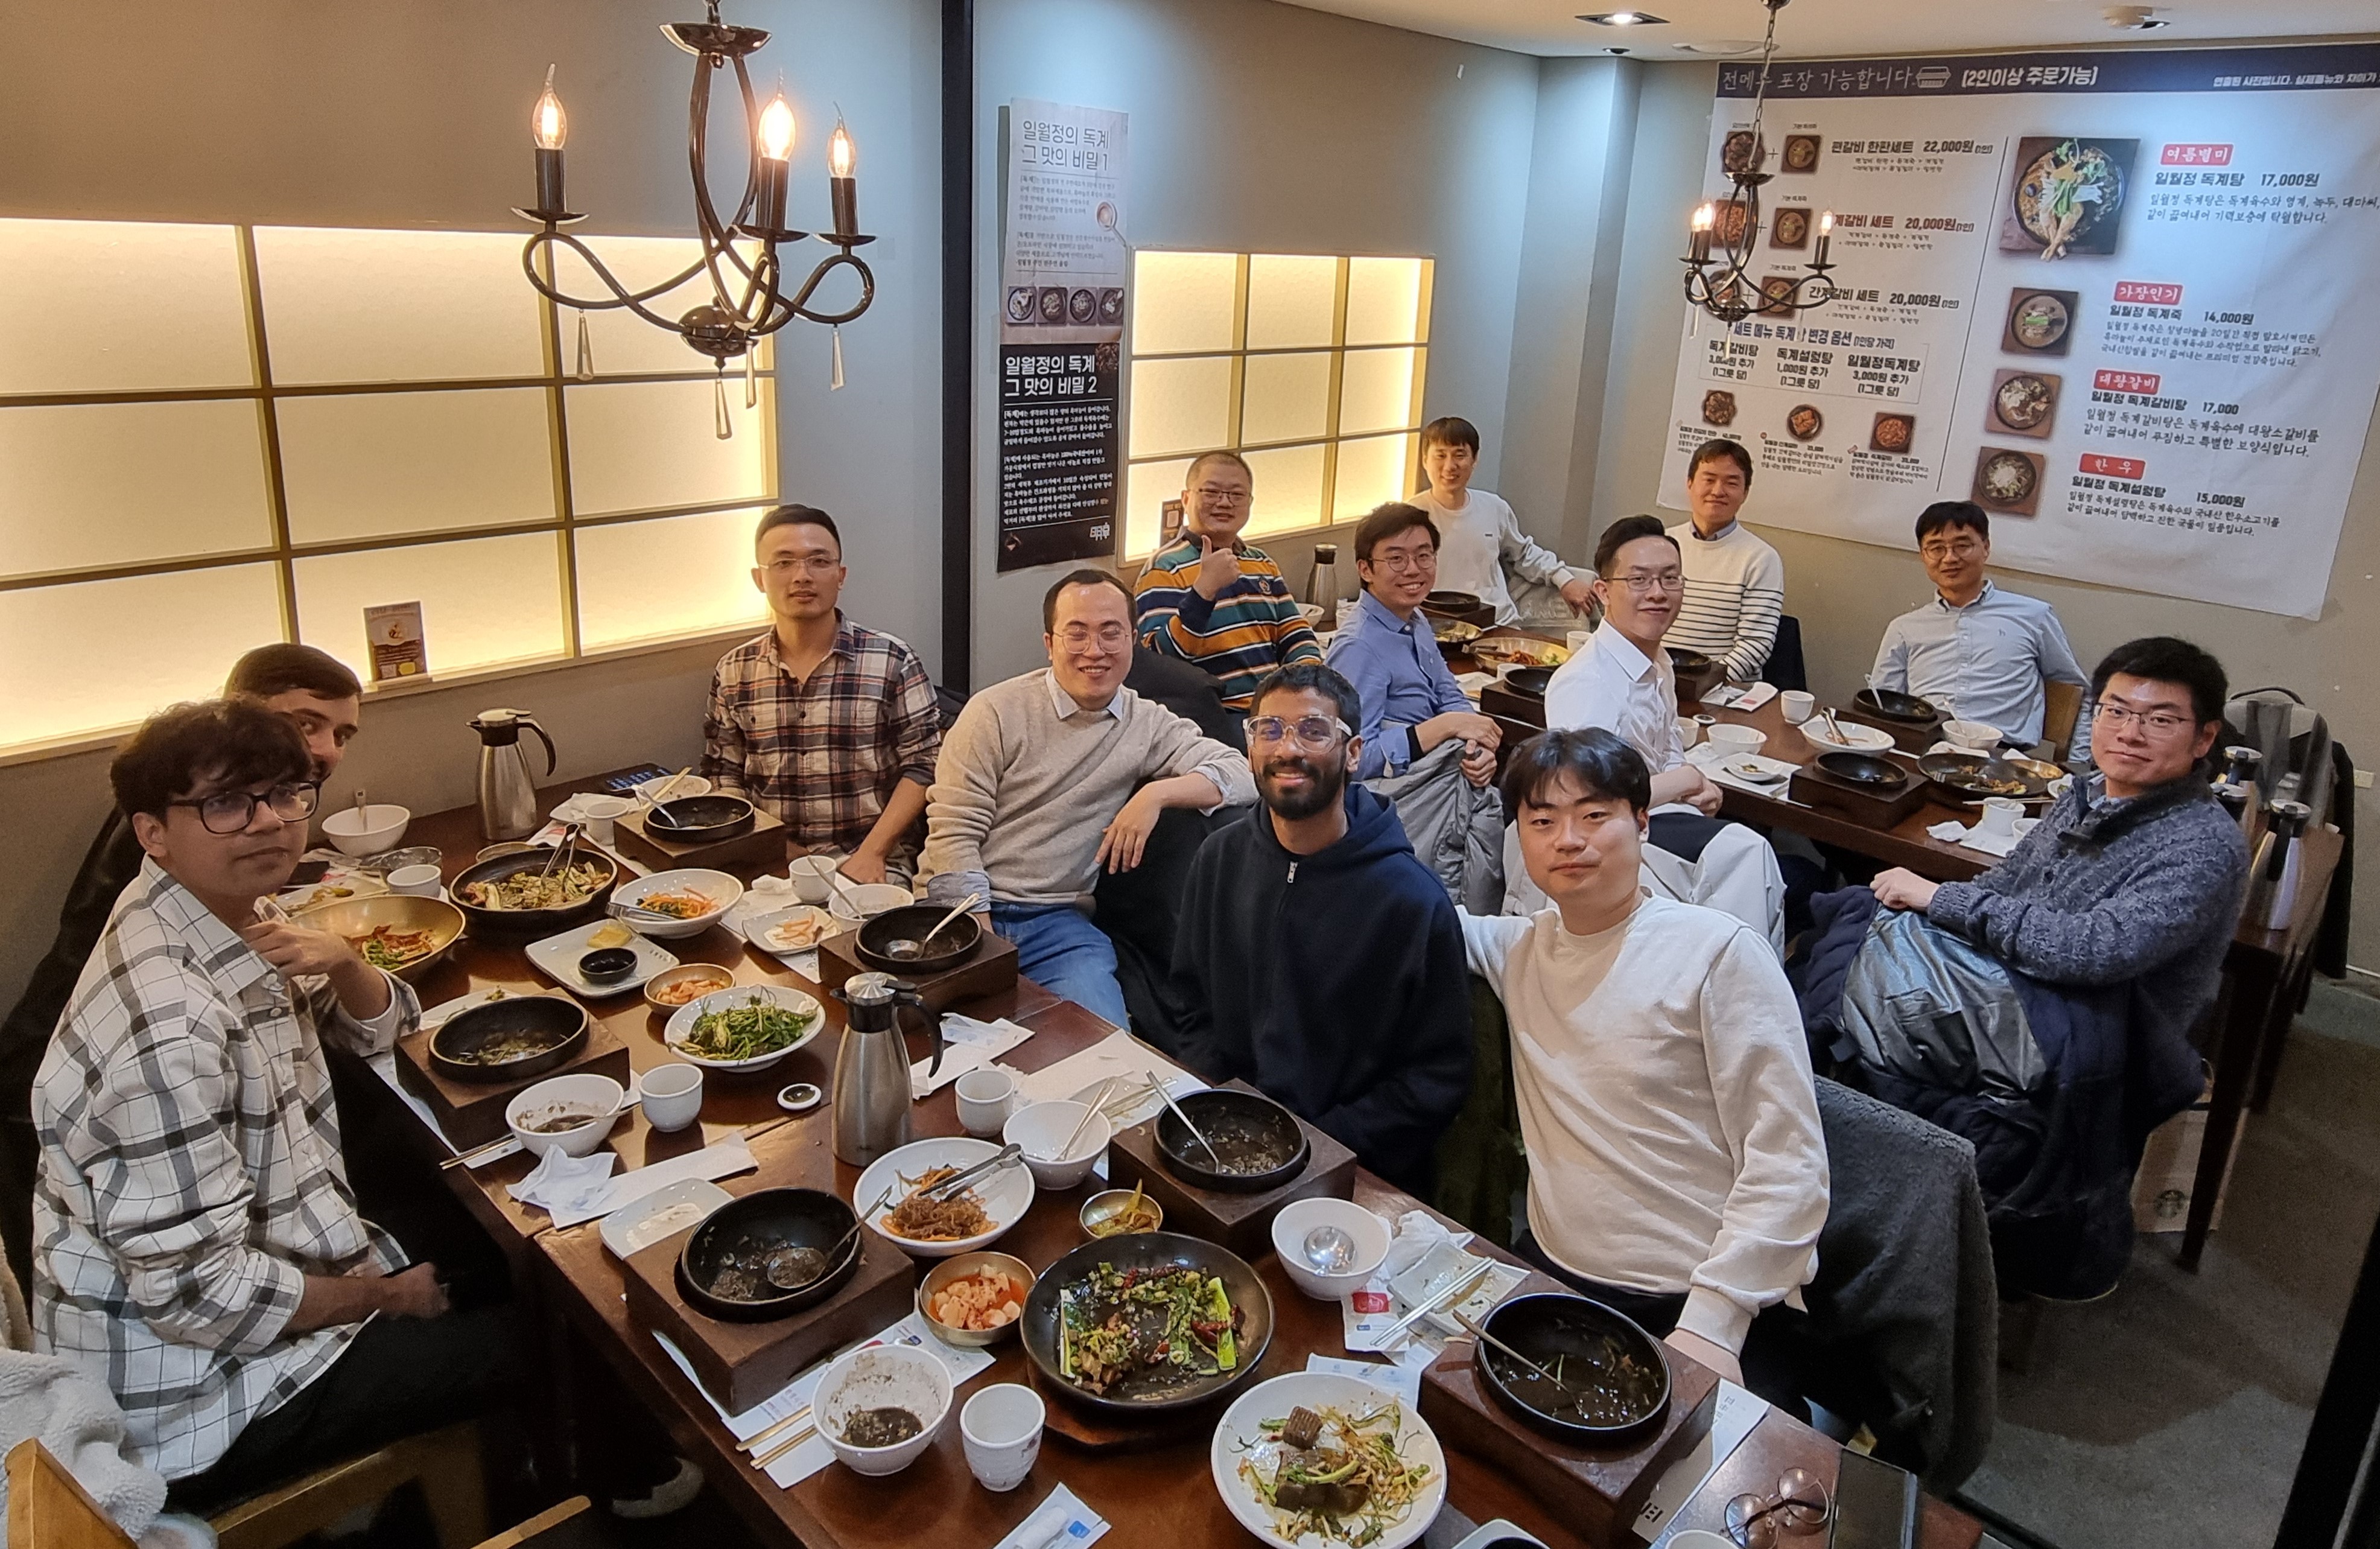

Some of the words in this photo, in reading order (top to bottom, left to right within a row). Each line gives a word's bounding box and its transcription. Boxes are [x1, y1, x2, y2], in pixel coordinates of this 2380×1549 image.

[1777, 69, 1814, 92] 포장
[1022, 120, 1079, 146] 일월정의
[1082, 128, 1110, 150] 독계
[1021, 144, 1037, 164] 그
[1041, 147, 1068, 168] 맛의
[1071, 151, 1099, 171] 비밀
[1103, 153, 1108, 171] 1
[1923, 140, 1975, 156] 22,000원
[2166, 146, 2229, 164] 여름별미
[2155, 172, 2198, 186] 일월정
[2200, 173, 2245, 187] 독계탕
[2261, 173, 2321, 188] 17,000원
[2150, 192, 2180, 206] 일월정
[2183, 194, 2225, 207] 독계탕은
[2227, 194, 2282, 208] 독계육수와
[2312, 196, 2339, 209] 녹두,
[1833, 214, 1868, 229] 계갈비
[1870, 215, 1894, 229] 세트
[1905, 217, 1957, 232] 20,000원
[2147, 208, 2167, 221] 같이
[2169, 209, 2211, 222] 끓여내어
[2214, 209, 2267, 224] 기력보충에
[2270, 211, 2328, 225] 탁월합니다.
[1856, 289, 1880, 302] 세트
[1888, 293, 1941, 308] 20,000원
[2119, 284, 2179, 302] 가장인기
[2110, 305, 2145, 319] 일월정
[2147, 307, 2183, 321] 독계죽
[2204, 311, 2255, 326] 14,000원
[1733, 322, 1753, 337] 세트
[1754, 323, 1773, 339] 메뉴
[1808, 329, 1830, 345] 변경
[1830, 330, 1853, 347] 옵션
[2107, 320, 2130, 331] 일월정
[2210, 328, 2240, 339] 20일간
[2216, 340, 2261, 352] 수작업으로
[1005, 354, 1065, 375] 일월정의
[1068, 354, 1096, 374] 독계
[1738, 357, 1755, 369] 추가
[1777, 348, 1834, 365] 독계설렁탕
[1847, 354, 1921, 373] 일월정독계탕
[2151, 348, 2168, 358] 같이
[2169, 349, 2203, 361] 끓여내는
[2204, 352, 2240, 364] 프리미엄
[1777, 362, 1809, 376] 1,000원
[1810, 366, 1829, 378] 추가
[1852, 370, 1888, 383] 3,000원
[1890, 374, 1909, 385] 추가
[1004, 378, 1020, 397] 그
[1024, 377, 1054, 397] 맛의
[1057, 375, 1085, 395] 비밀
[1087, 375, 1097, 393] 2
[2099, 372, 2156, 391] 대왕갈비
[2091, 390, 2125, 405] 일월정
[2128, 394, 2188, 412] 독계갈비탕
[2203, 401, 2240, 415] 17,000
[2087, 408, 2116, 422] 일월정
[2120, 411, 2185, 430] 독계갈비탕은
[2188, 418, 2245, 436] 독계육수에
[2248, 424, 2320, 444] 대왕소갈비를
[2084, 422, 2104, 436] 같이
[2106, 425, 2148, 441] 끓여내어
[2151, 431, 2195, 445] 푸짐하고
[2199, 435, 2235, 451] 특별한
[2236, 440, 2309, 459] 보양식입니다.
[2072, 475, 2106, 490] 일월정
[2108, 480, 2167, 499] 독계설렁탕
[2196, 491, 2246, 509] 15,000원
[2067, 501, 2084, 514] 같이
[2085, 504, 2118, 518] 끓여내어
[2121, 511, 2154, 523] 담백하고
[2157, 515, 2176, 527] 진한
[2177, 518, 2206, 530] 국물이
[2207, 521, 2255, 537] 일품입니다.
[2069, 491, 2093, 503] 일월정
[2095, 495, 2146, 511] 독계설렁탕은
[2148, 501, 2194, 515] 독계육수와
[2195, 507, 2223, 521] 국내산
[2225, 511, 2281, 528] 한우소고기를
